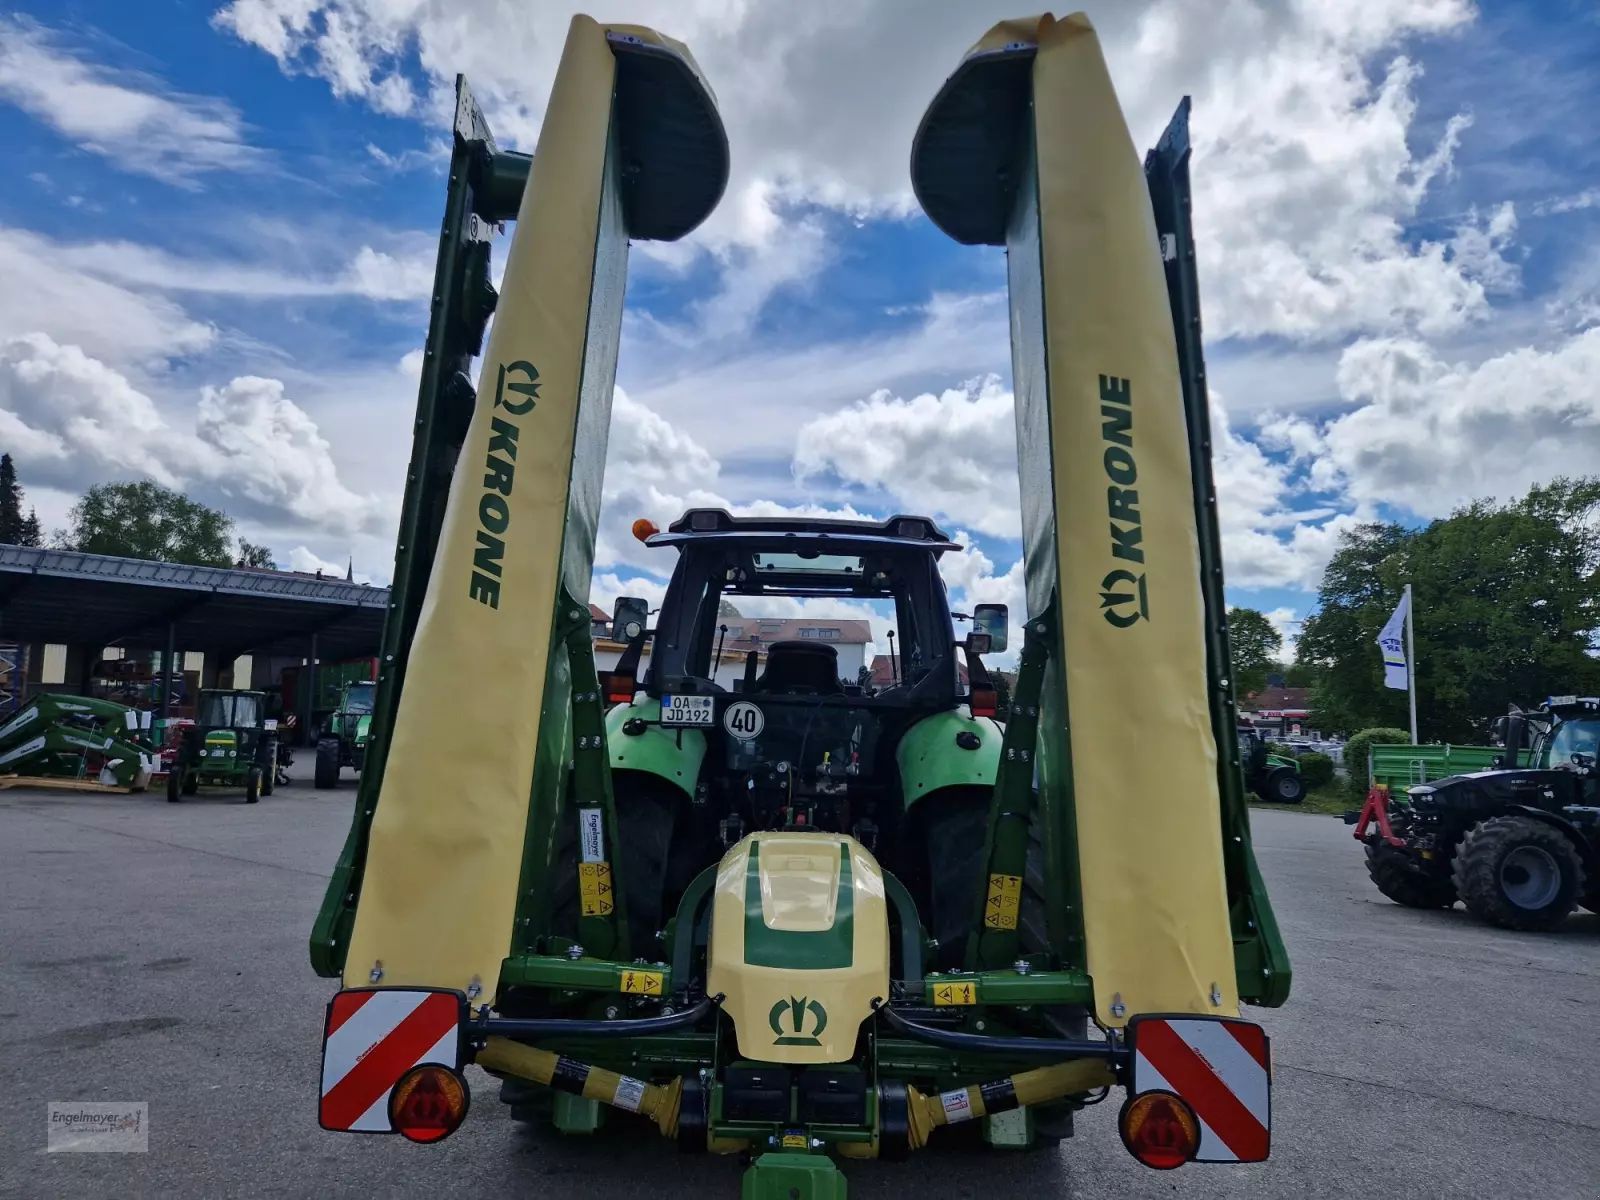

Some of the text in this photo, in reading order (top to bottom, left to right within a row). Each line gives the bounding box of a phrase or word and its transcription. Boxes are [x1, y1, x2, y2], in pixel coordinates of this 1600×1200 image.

[1098, 374, 1145, 565] KRONE
[469, 416, 520, 610] KRONE
[673, 697, 690, 708] OA
[731, 708, 756, 733] 40
[590, 814, 601, 857] Engelmayer
